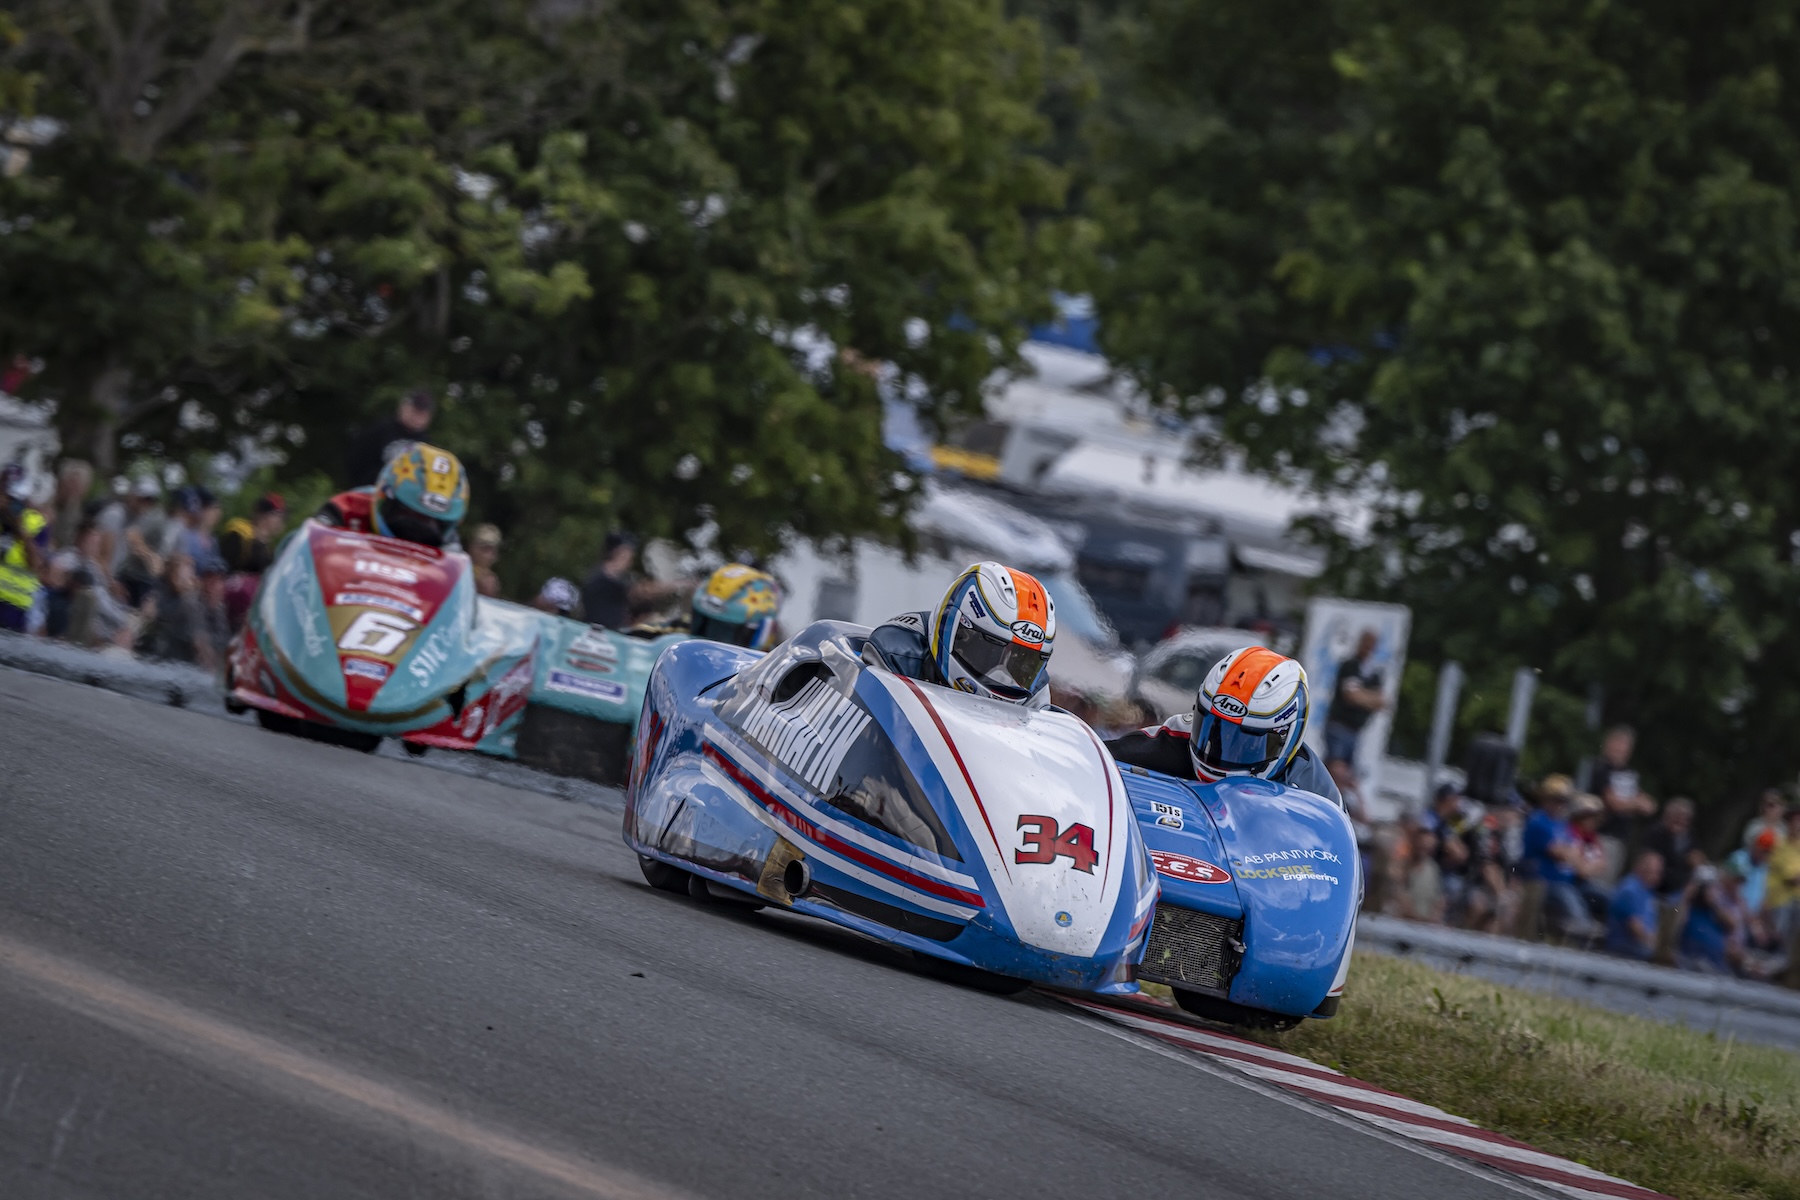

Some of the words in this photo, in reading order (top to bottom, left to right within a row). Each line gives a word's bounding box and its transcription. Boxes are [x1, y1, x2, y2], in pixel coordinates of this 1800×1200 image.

[337, 610, 418, 656] 6
[1013, 622, 1044, 640] Arai
[1213, 696, 1246, 715] Arai
[1014, 814, 1100, 877] 34
[1244, 855, 1264, 865] AB
[1263, 849, 1342, 865] PAINTWORX
[1235, 864, 1316, 880] LOCKSIDE
[1282, 872, 1339, 885] Engineering
